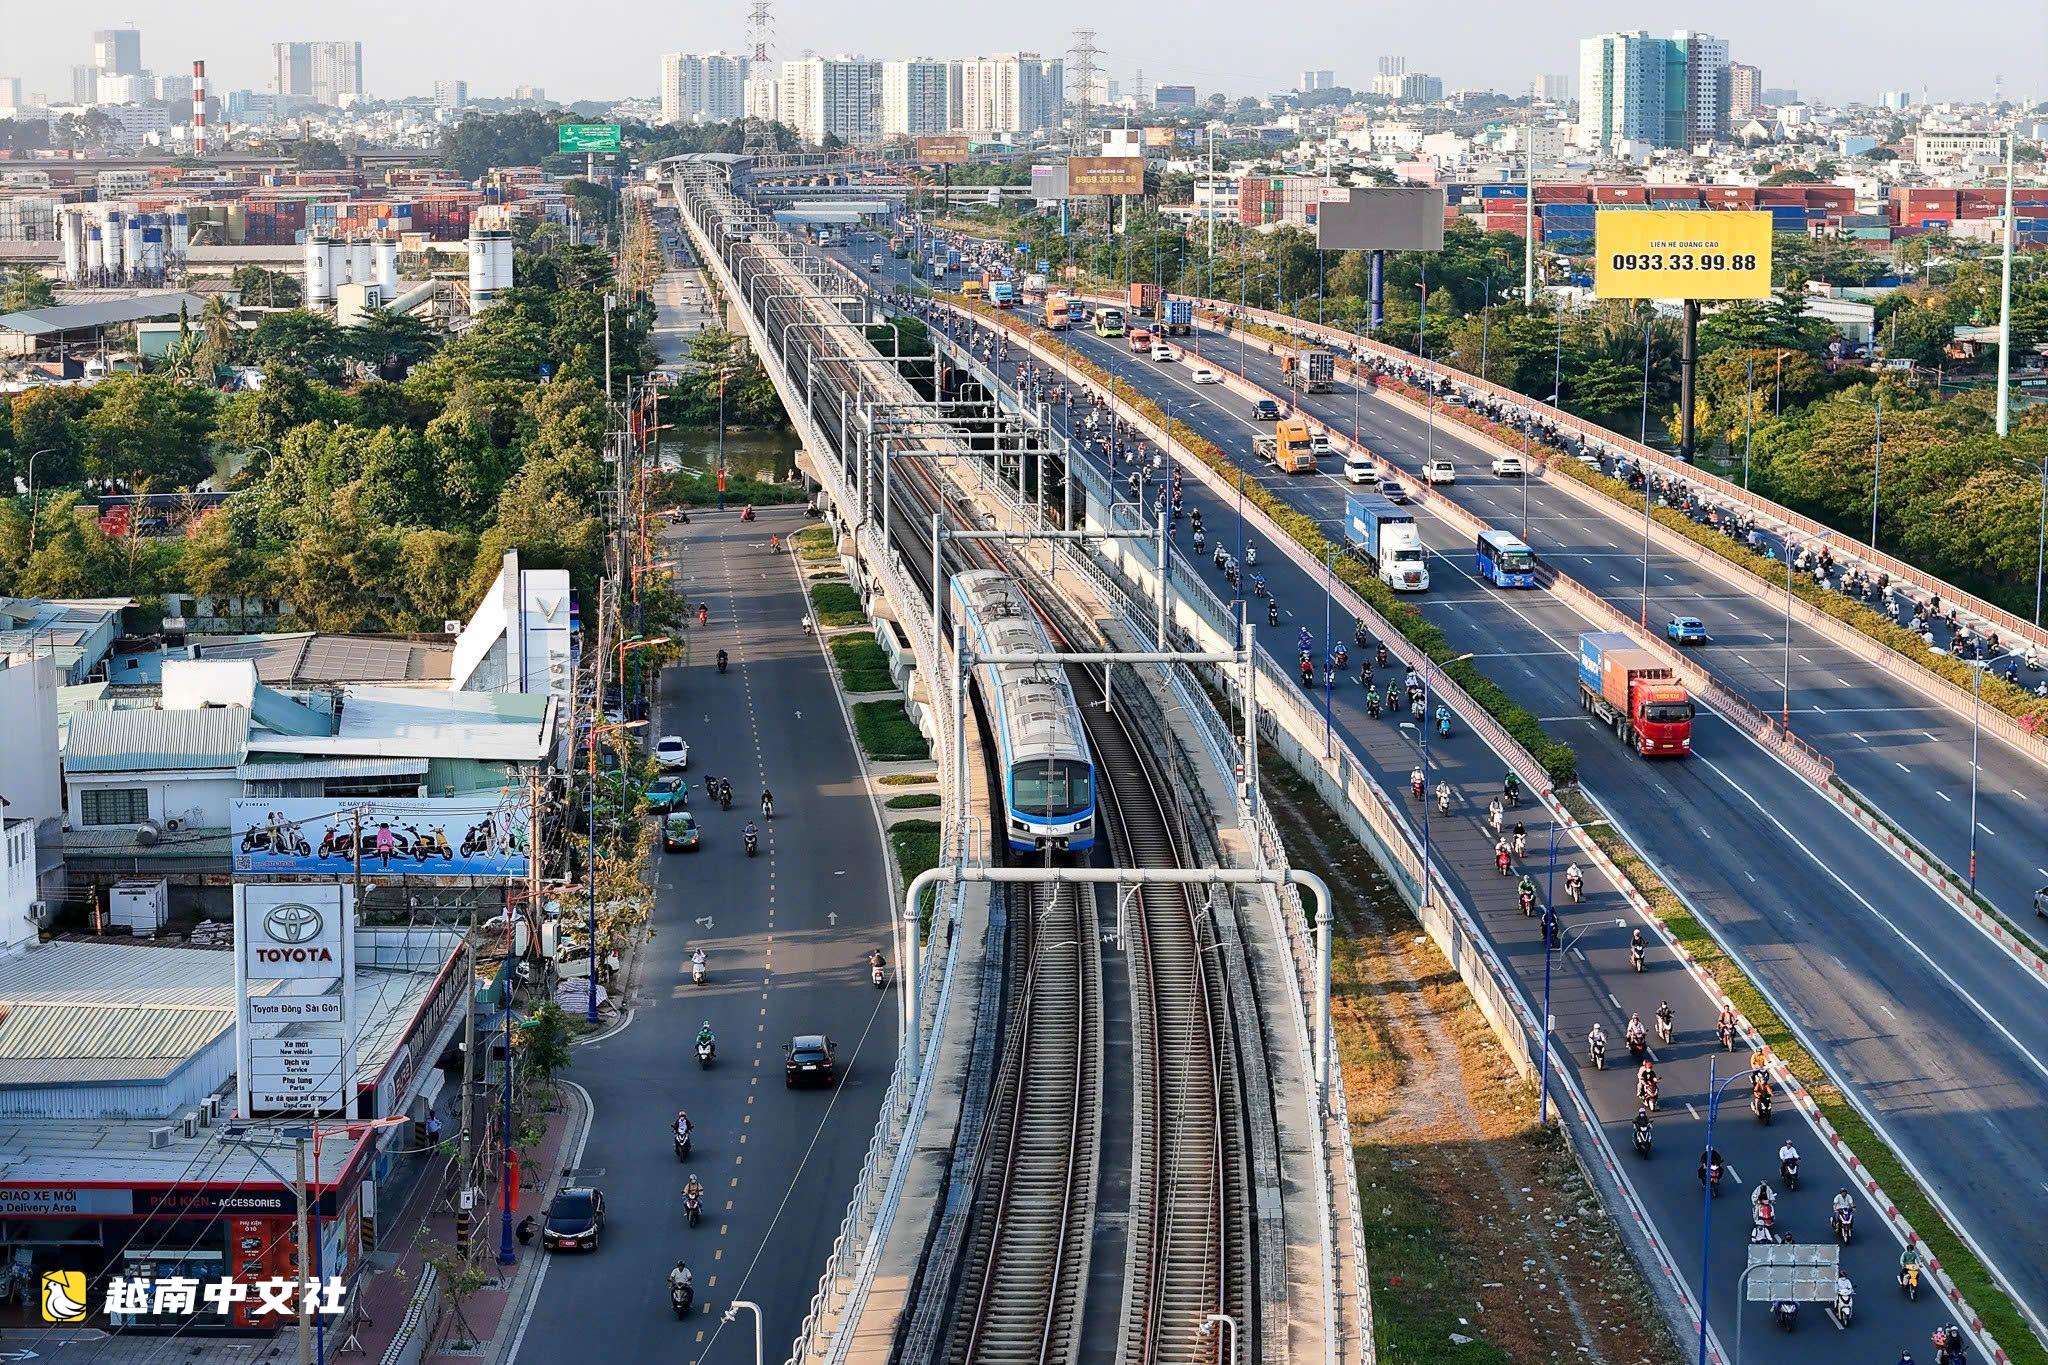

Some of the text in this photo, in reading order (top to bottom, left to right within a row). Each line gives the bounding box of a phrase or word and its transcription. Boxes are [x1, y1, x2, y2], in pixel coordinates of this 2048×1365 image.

[1612, 254, 1757, 271] 0933.33.99.88
[256, 947, 333, 962] TOYOTA
[253, 1003, 339, 1015] Toyota Đông Sài Gòn
[0, 1188, 77, 1201] GIAO XE MỚI
[6, 1203, 50, 1213] Delivery
[52, 1203, 77, 1213] Area
[218, 1198, 282, 1208] ACCESSORIES
